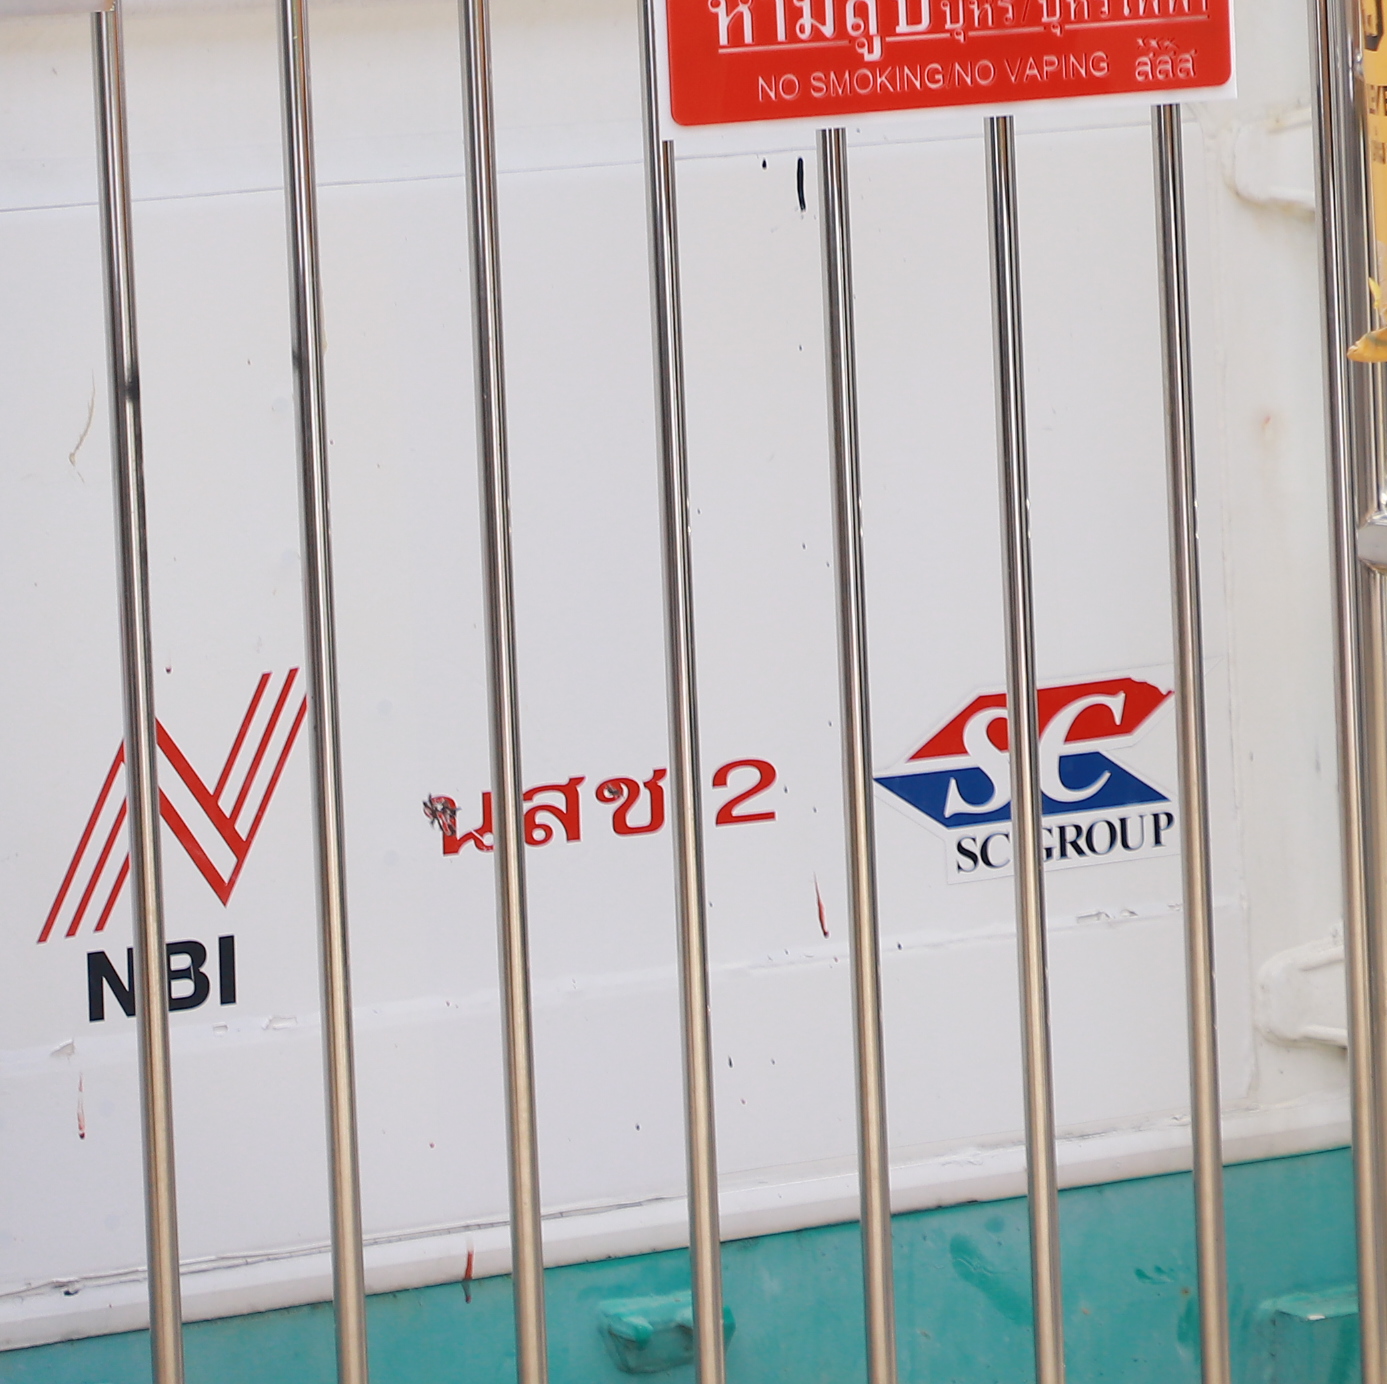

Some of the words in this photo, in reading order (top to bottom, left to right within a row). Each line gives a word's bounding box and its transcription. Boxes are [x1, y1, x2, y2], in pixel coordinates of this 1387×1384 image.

[758, 73, 800, 102] NO
[1005, 51, 1110, 83] VAPING
[711, 758, 778, 827] 2
[956, 832, 1011, 874] SC
[86, 934, 238, 1024] NBI
